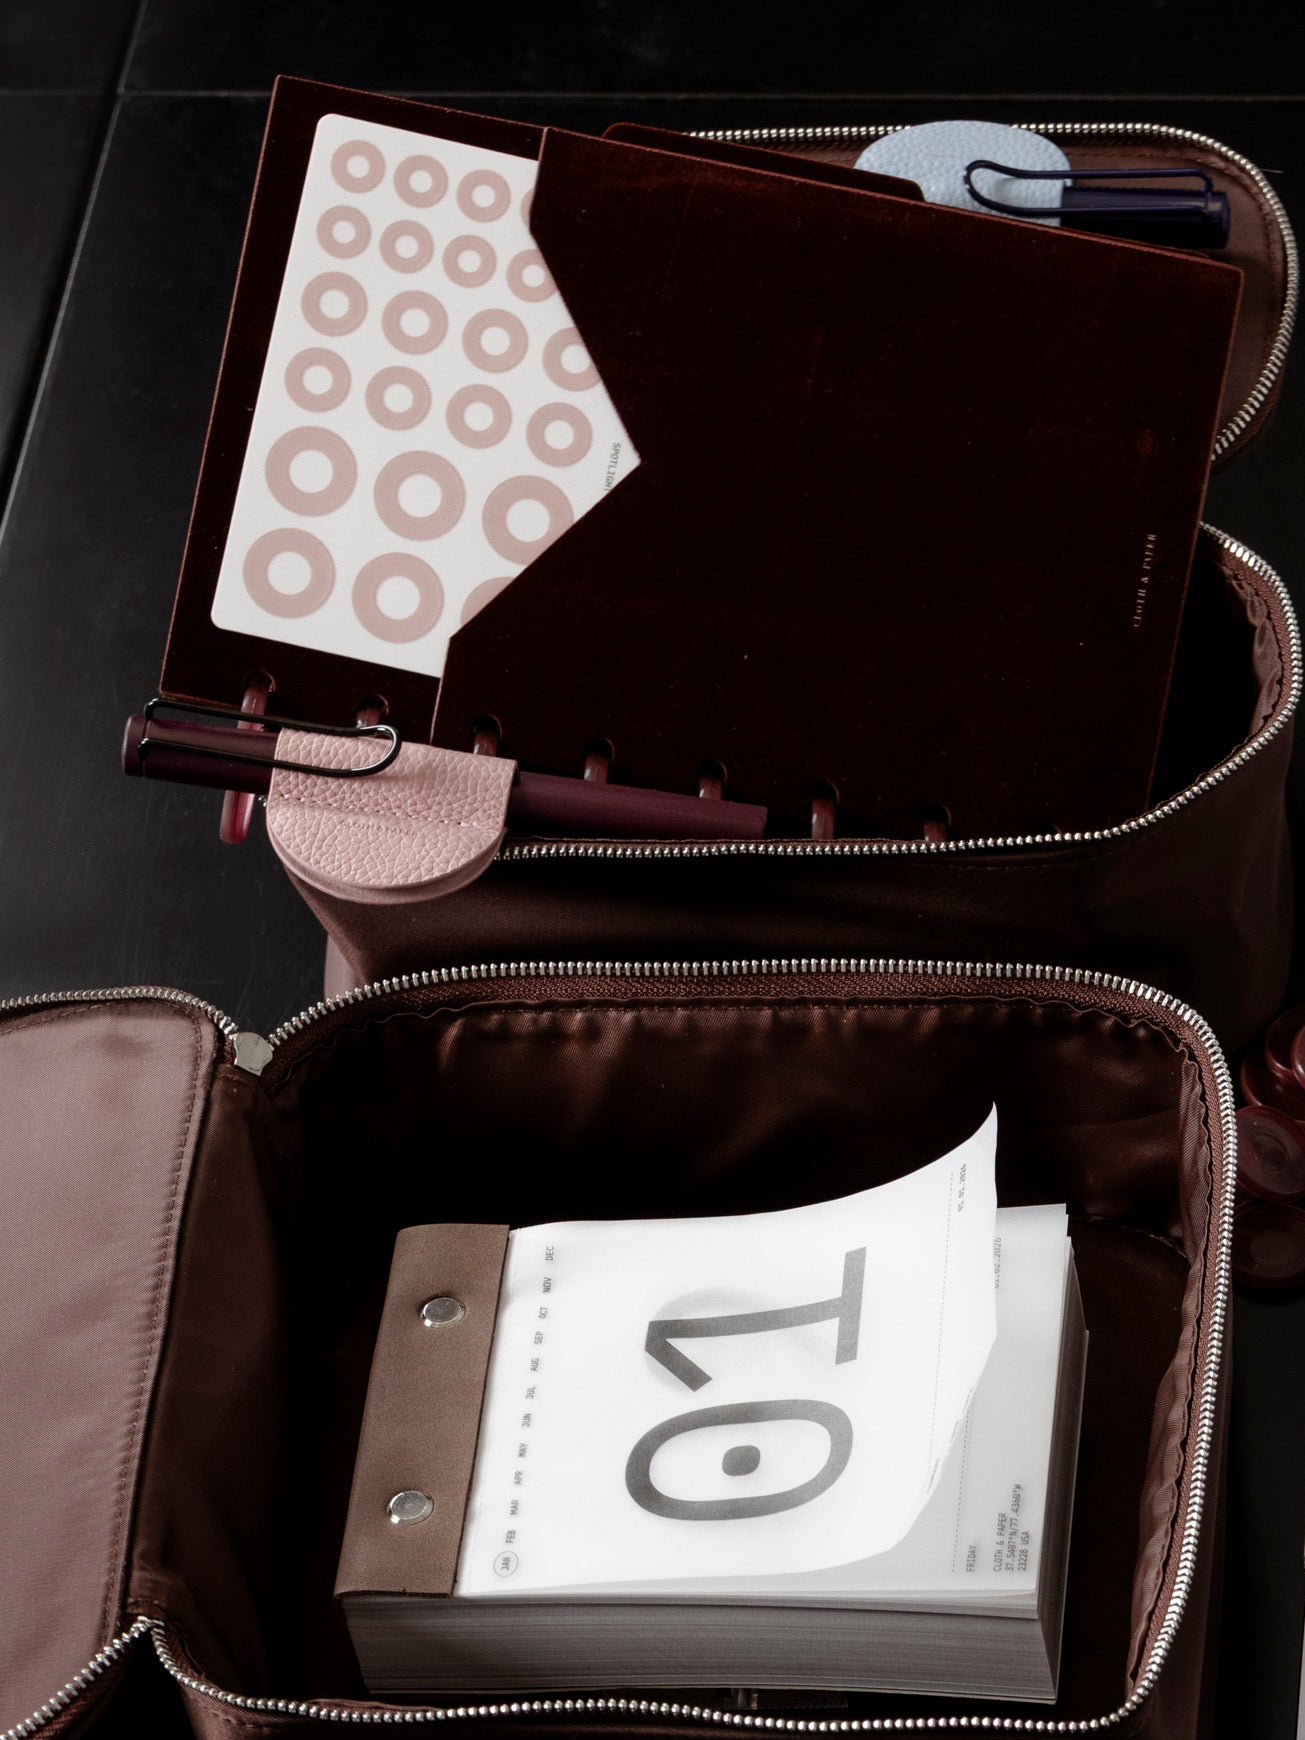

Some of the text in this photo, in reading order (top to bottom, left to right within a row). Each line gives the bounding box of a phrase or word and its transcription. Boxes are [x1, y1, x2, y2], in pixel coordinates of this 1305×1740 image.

[624, 1246, 868, 1522] 01
[500, 1246, 555, 1571] JAN FEB MAR APR MAY JUN JUL AUG SEP OCT NOV DEC
[996, 1512, 1008, 1537] PAPER
[965, 1543, 979, 1573] FRIDAY
[993, 1549, 1004, 1572] CLOTH
[1017, 1530, 1031, 1572] 23228 USA
